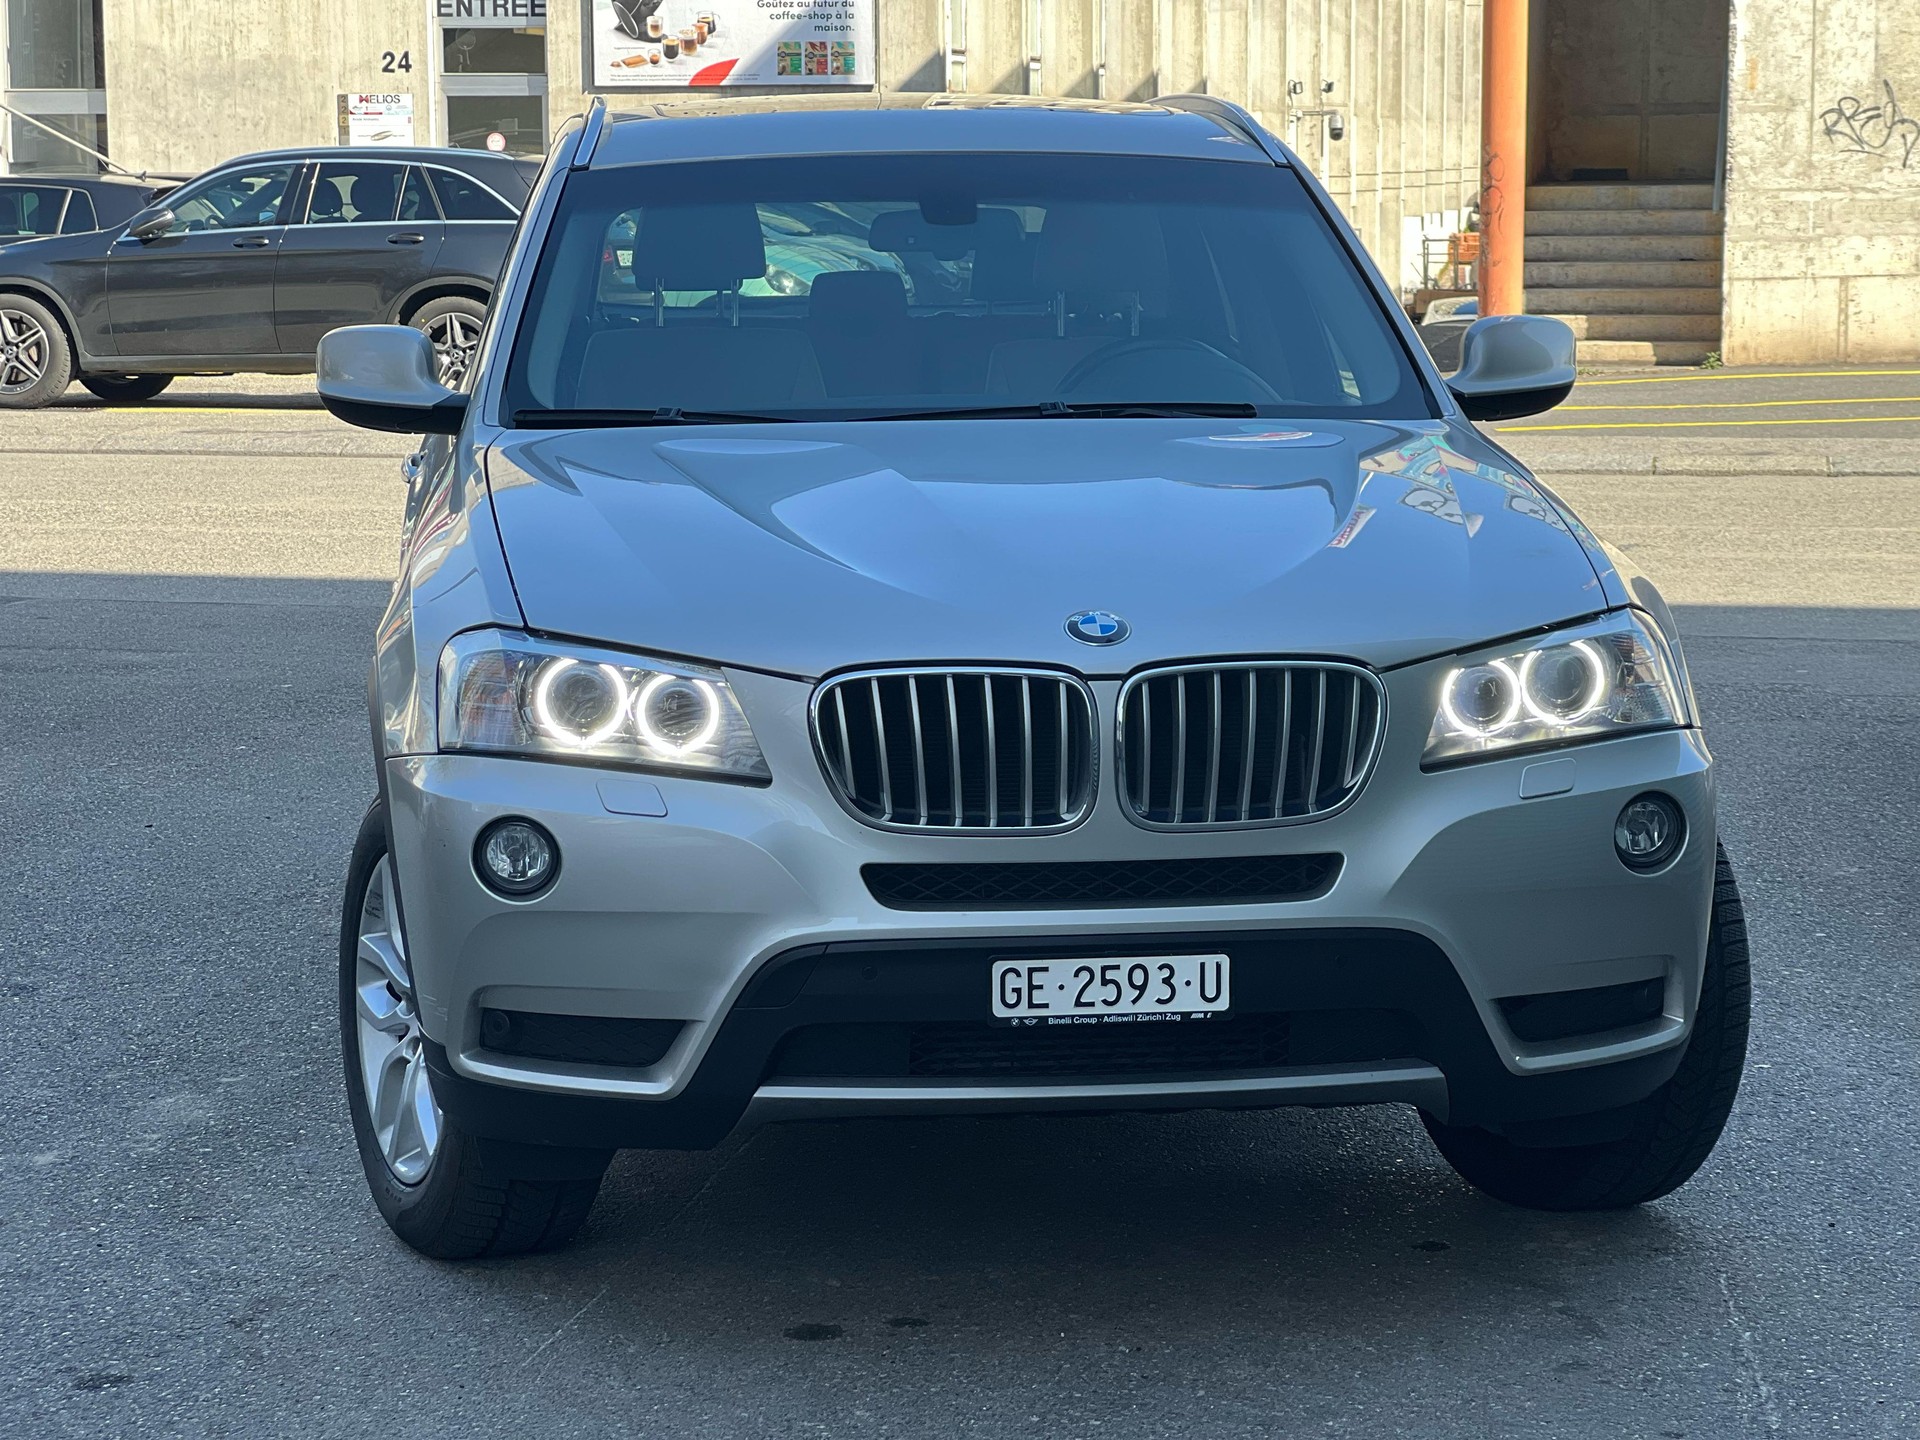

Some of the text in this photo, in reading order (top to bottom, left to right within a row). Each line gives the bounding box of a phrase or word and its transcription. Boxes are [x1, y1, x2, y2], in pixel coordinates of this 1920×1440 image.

[797, 0, 810, 8] au
[769, 10, 855, 21] coffee-shop à la
[814, 23, 855, 31] maison.
[381, 51, 412, 73] 24
[1048, 1017, 1072, 1025] Binelli
[1073, 1015, 1098, 1024] Group
[1103, 1014, 1133, 1023] Adliswil
[1136, 1013, 1162, 1021] Zürich
[1165, 1012, 1181, 1021] Zug
